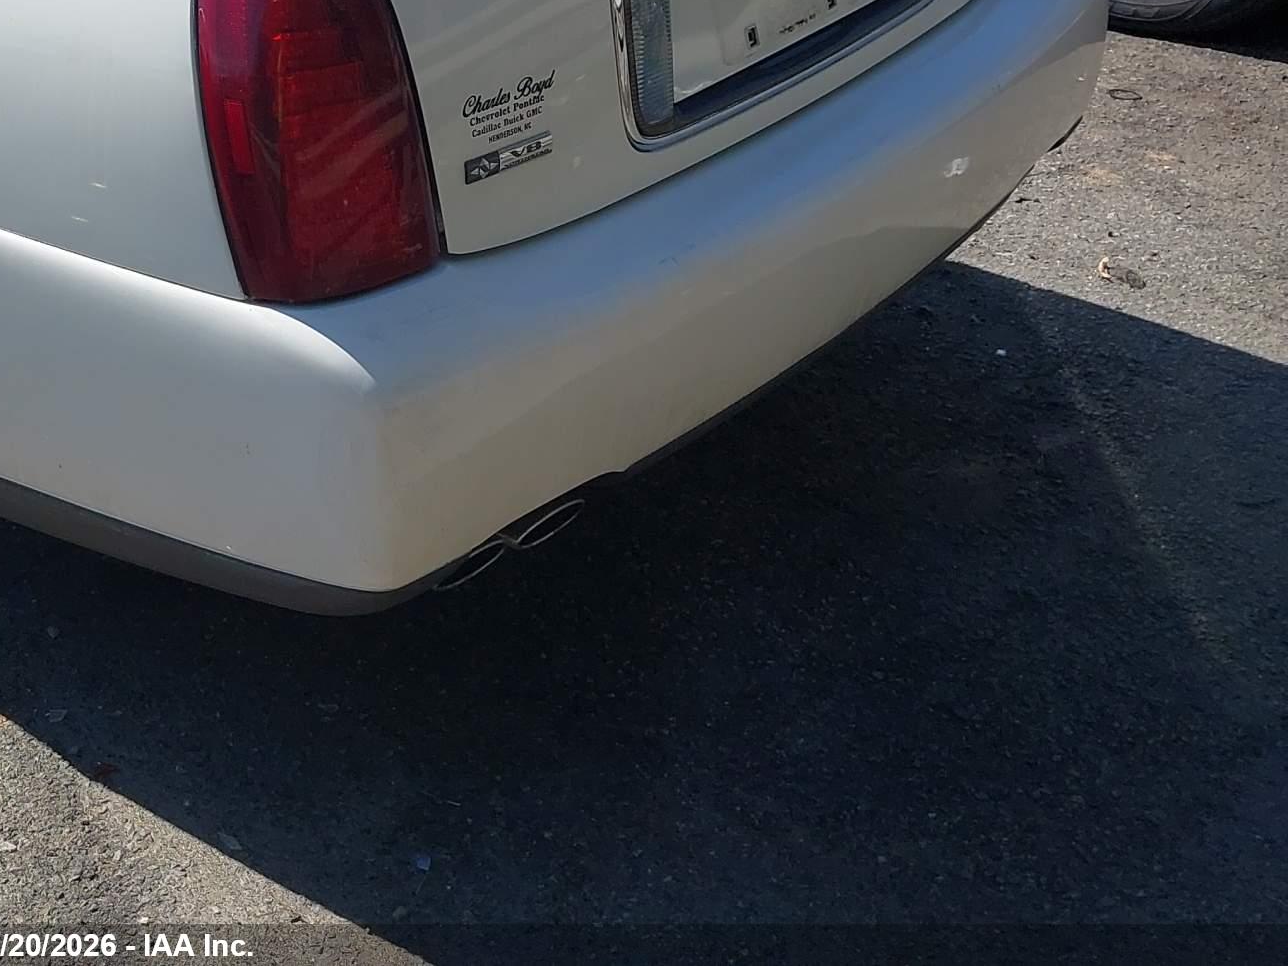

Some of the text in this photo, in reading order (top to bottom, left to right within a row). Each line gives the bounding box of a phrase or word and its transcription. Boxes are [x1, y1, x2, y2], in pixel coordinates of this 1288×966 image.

[462, 69, 556, 118] Charles Boyd
[469, 94, 545, 127] Chevrolet Pontiac
[472, 105, 543, 138] Cadillac Buick GMC
